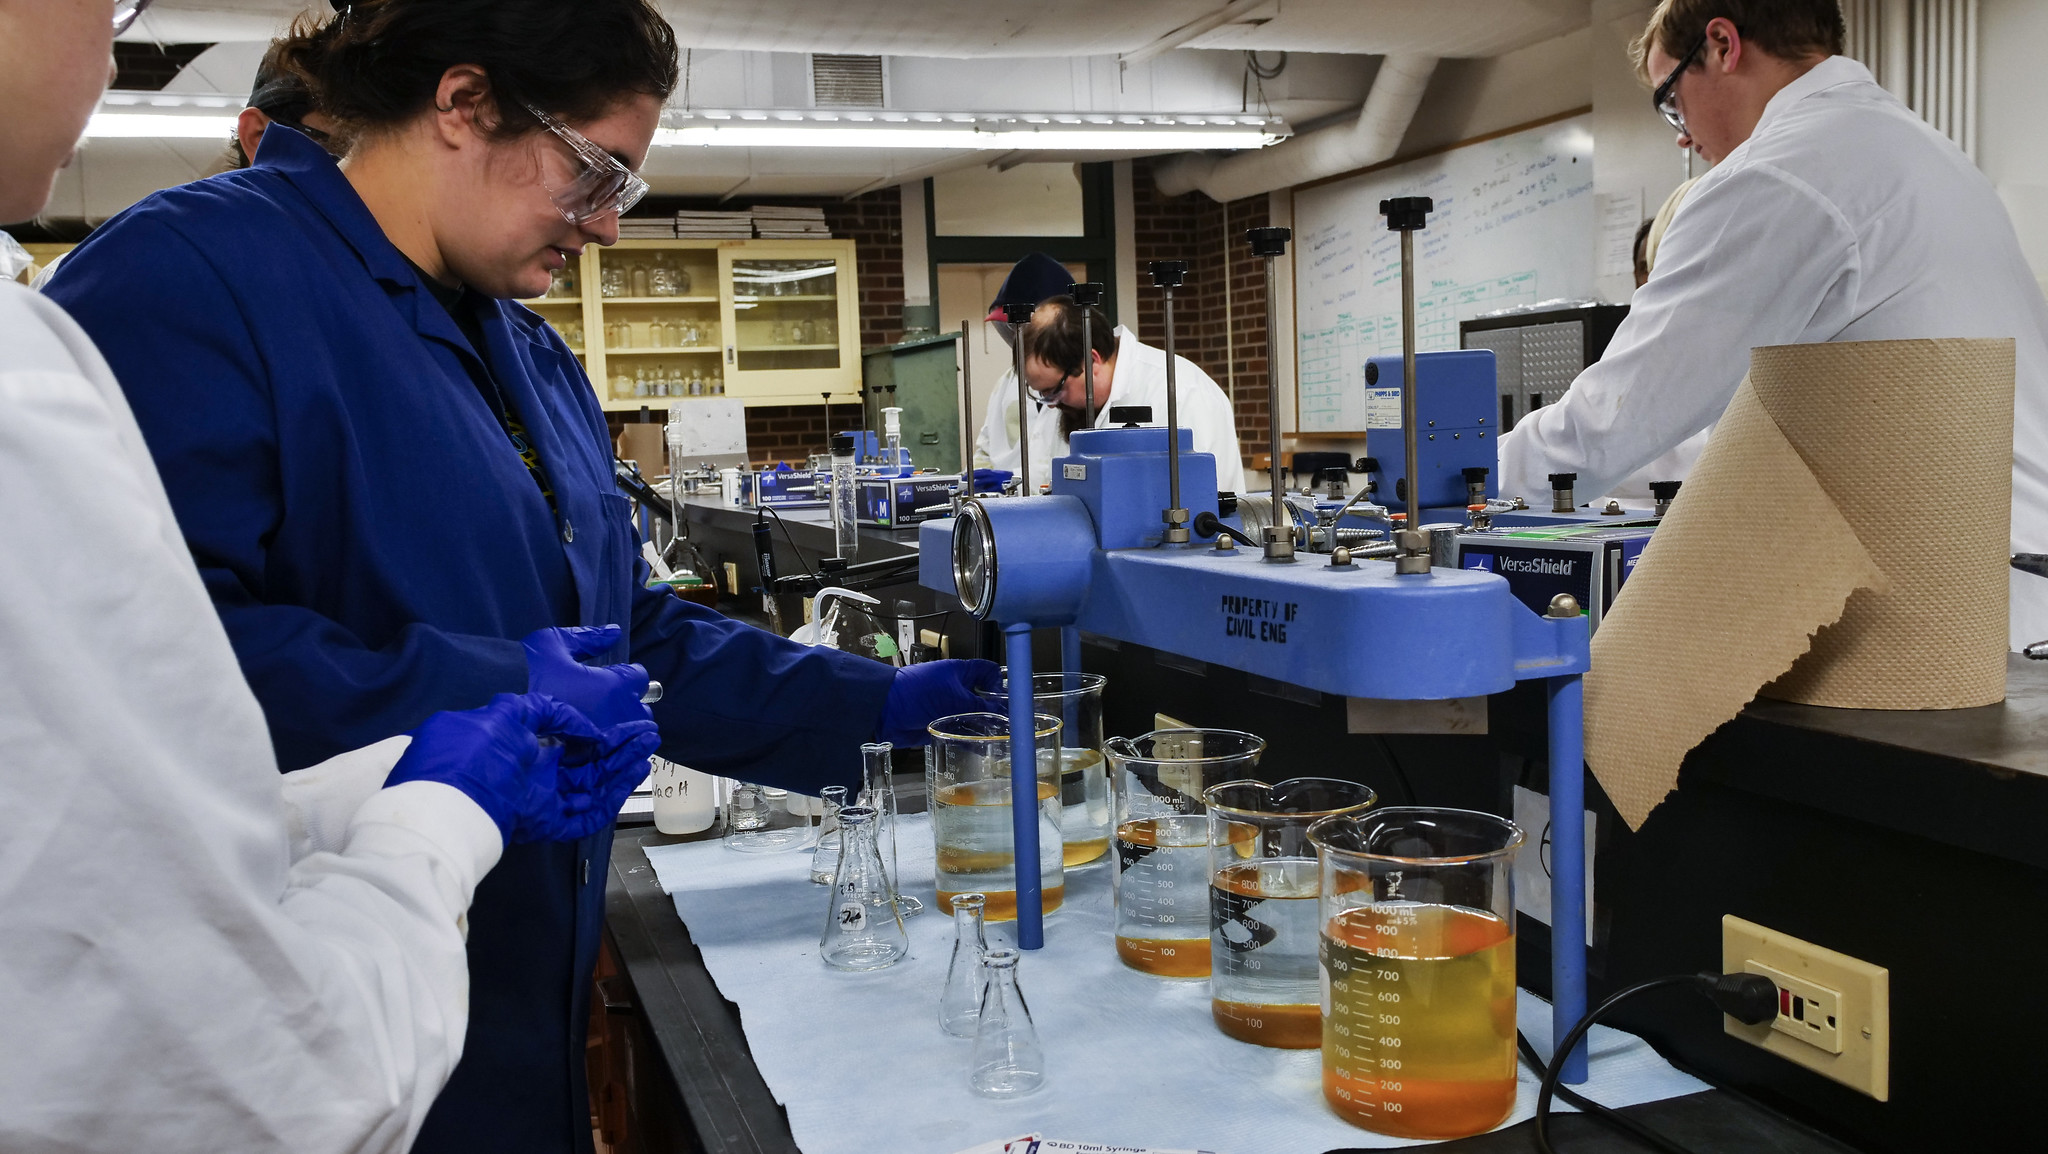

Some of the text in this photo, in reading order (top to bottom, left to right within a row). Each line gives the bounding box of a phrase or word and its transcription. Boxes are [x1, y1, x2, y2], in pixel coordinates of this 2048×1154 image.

[777, 472, 811, 480] VersaShield
[879, 501, 887, 517] M
[1222, 594, 1298, 622] PROPERTY OF
[1226, 616, 1287, 644] CIVIL ENG
[944, 771, 954, 780] 900
[1151, 796, 1185, 804] 1000 mL
[1122, 840, 1134, 850] 300
[1156, 846, 1172, 854] 700
[1124, 856, 1134, 866] 400
[1158, 880, 1174, 888] 500
[1158, 898, 1174, 906] 400
[1242, 900, 1259, 909] 700
[1371, 904, 1416, 916] 1000 mL
[1158, 914, 1174, 922] 300
[1242, 920, 1260, 930] 600
[1376, 924, 1398, 936] 900
[1126, 940, 1137, 950] 900
[1243, 940, 1260, 950] 500
[1161, 948, 1176, 956] 100
[1377, 947, 1398, 958] 800
[1244, 959, 1260, 970] 400
[1333, 959, 1348, 972] 300
[1377, 970, 1400, 982] 700
[1334, 980, 1348, 993] 400
[1378, 992, 1400, 1002] 600
[1334, 1002, 1348, 1015] 500
[1246, 1018, 1262, 1028] 100
[1379, 1014, 1400, 1025] 500
[1334, 1023, 1350, 1037] 600
[1379, 1036, 1402, 1048] 400
[1335, 1044, 1350, 1058] 700
[1380, 1058, 1402, 1070] 300
[1336, 1066, 1350, 1080] 800
[1380, 1080, 1402, 1092] 200
[1336, 1086, 1351, 1101] 900
[1384, 1102, 1402, 1113] 100
[1059, 1142, 1074, 1150] BD
[1078, 1144, 1103, 1152] 10ml
